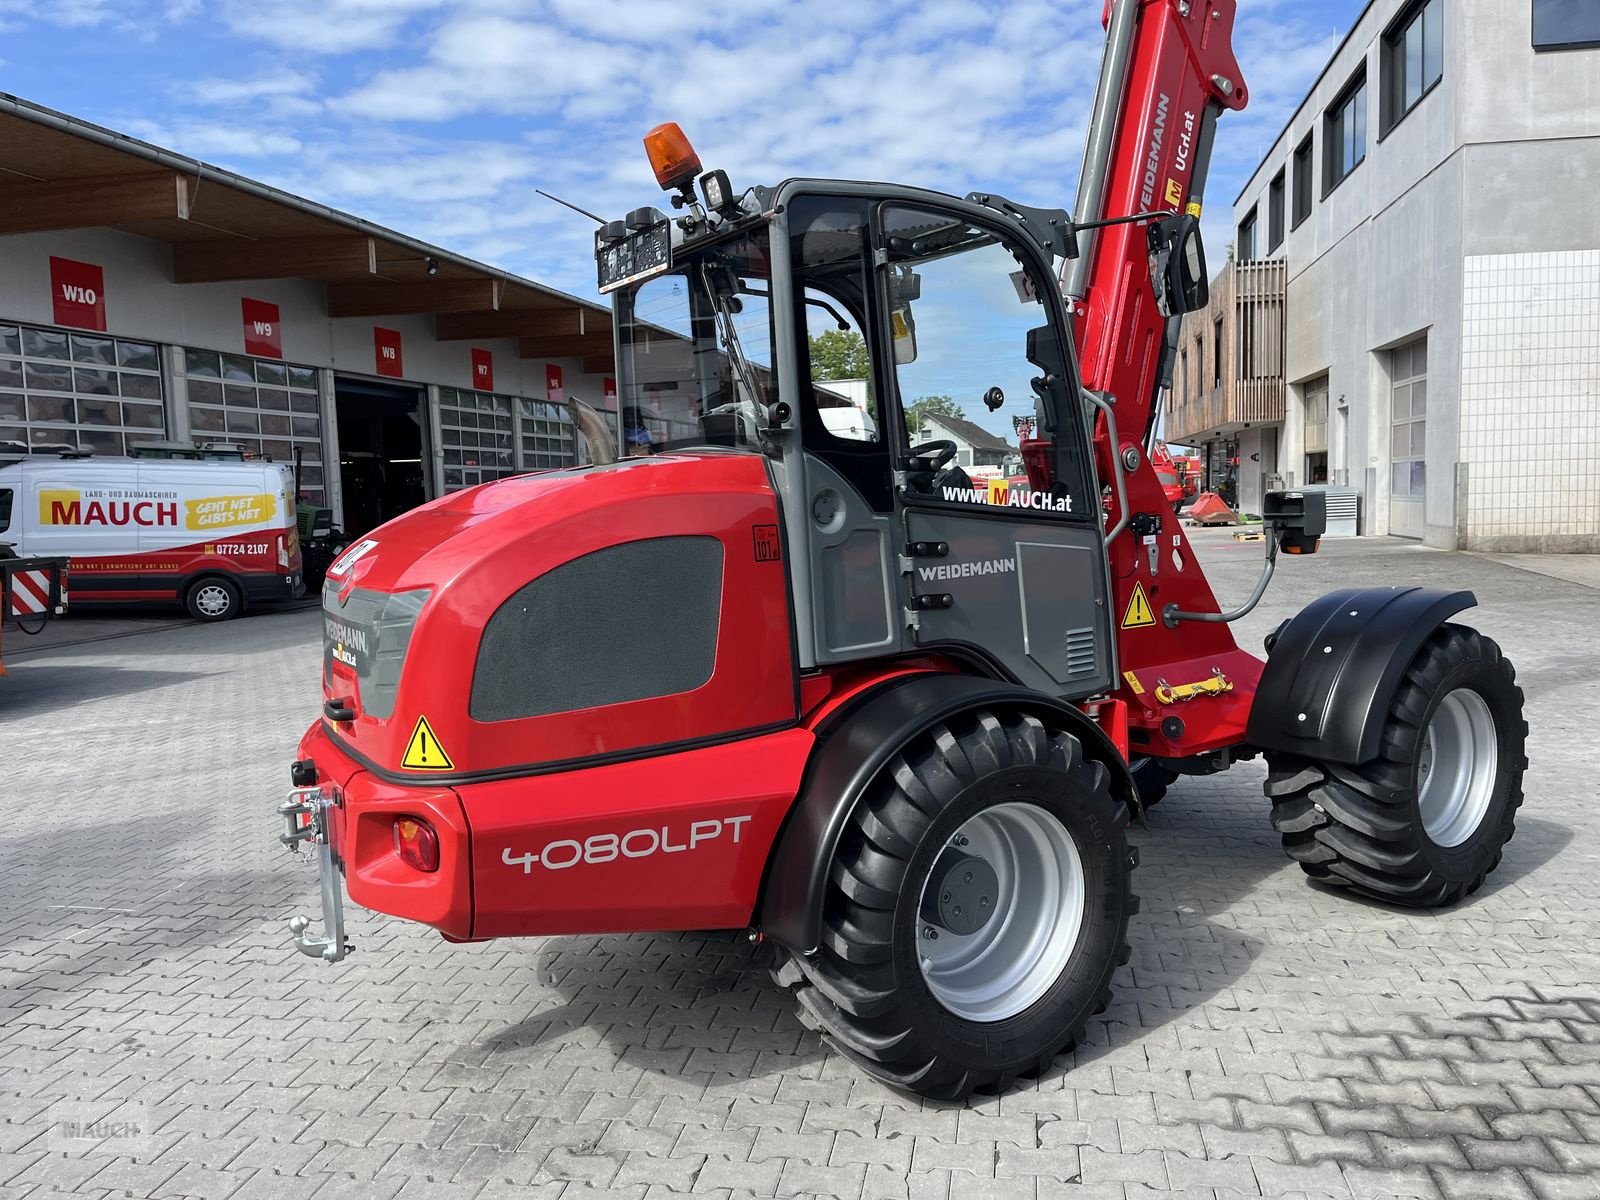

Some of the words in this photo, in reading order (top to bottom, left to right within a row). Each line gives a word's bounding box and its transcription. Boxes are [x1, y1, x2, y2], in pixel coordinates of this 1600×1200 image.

[62, 284, 96, 305] W10
[253, 321, 272, 337] W9
[382, 346, 396, 360] W8
[477, 364, 488, 376] W7
[85, 490, 107, 498] LAND-
[124, 491, 178, 499] BAUMASCHINEN
[942, 485, 1072, 512] www.MAUCH.at
[51, 500, 178, 526] MAUCH
[196, 500, 228, 514] GEHT
[230, 497, 254, 510] NET
[198, 511, 235, 525] GIBTS
[237, 508, 261, 521] NET
[216, 544, 245, 555] 07724
[247, 544, 268, 555] 2107
[918, 558, 1015, 582] WEIDEMANN
[501, 815, 752, 874] 4080LPT
